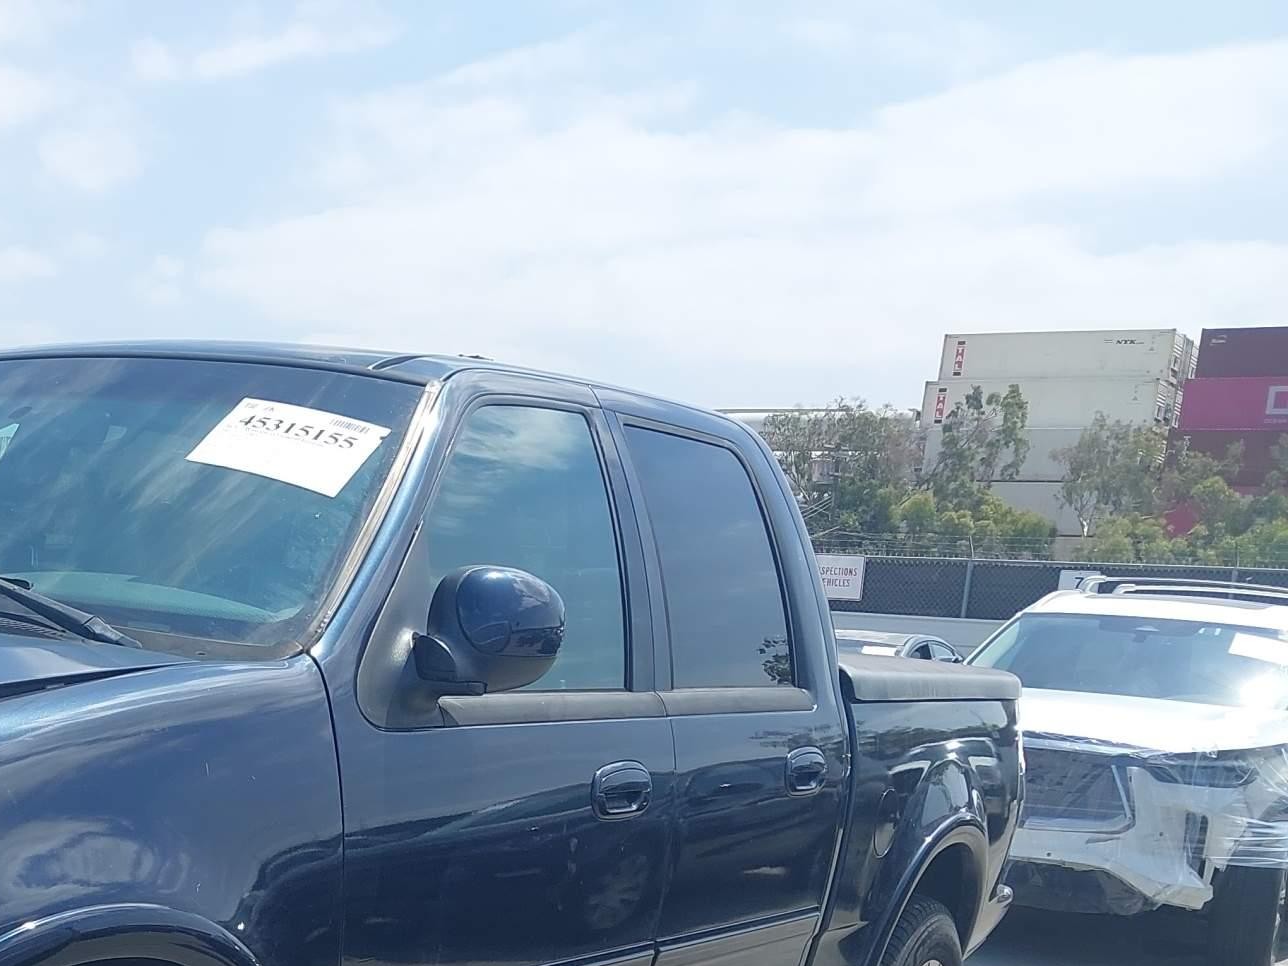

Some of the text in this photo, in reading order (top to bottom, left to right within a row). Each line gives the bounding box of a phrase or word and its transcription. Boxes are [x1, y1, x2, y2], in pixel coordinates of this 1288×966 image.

[239, 415, 359, 449] 45315155
[819, 566, 858, 576] SPECTIONS
[822, 578, 851, 587] EHICLES
